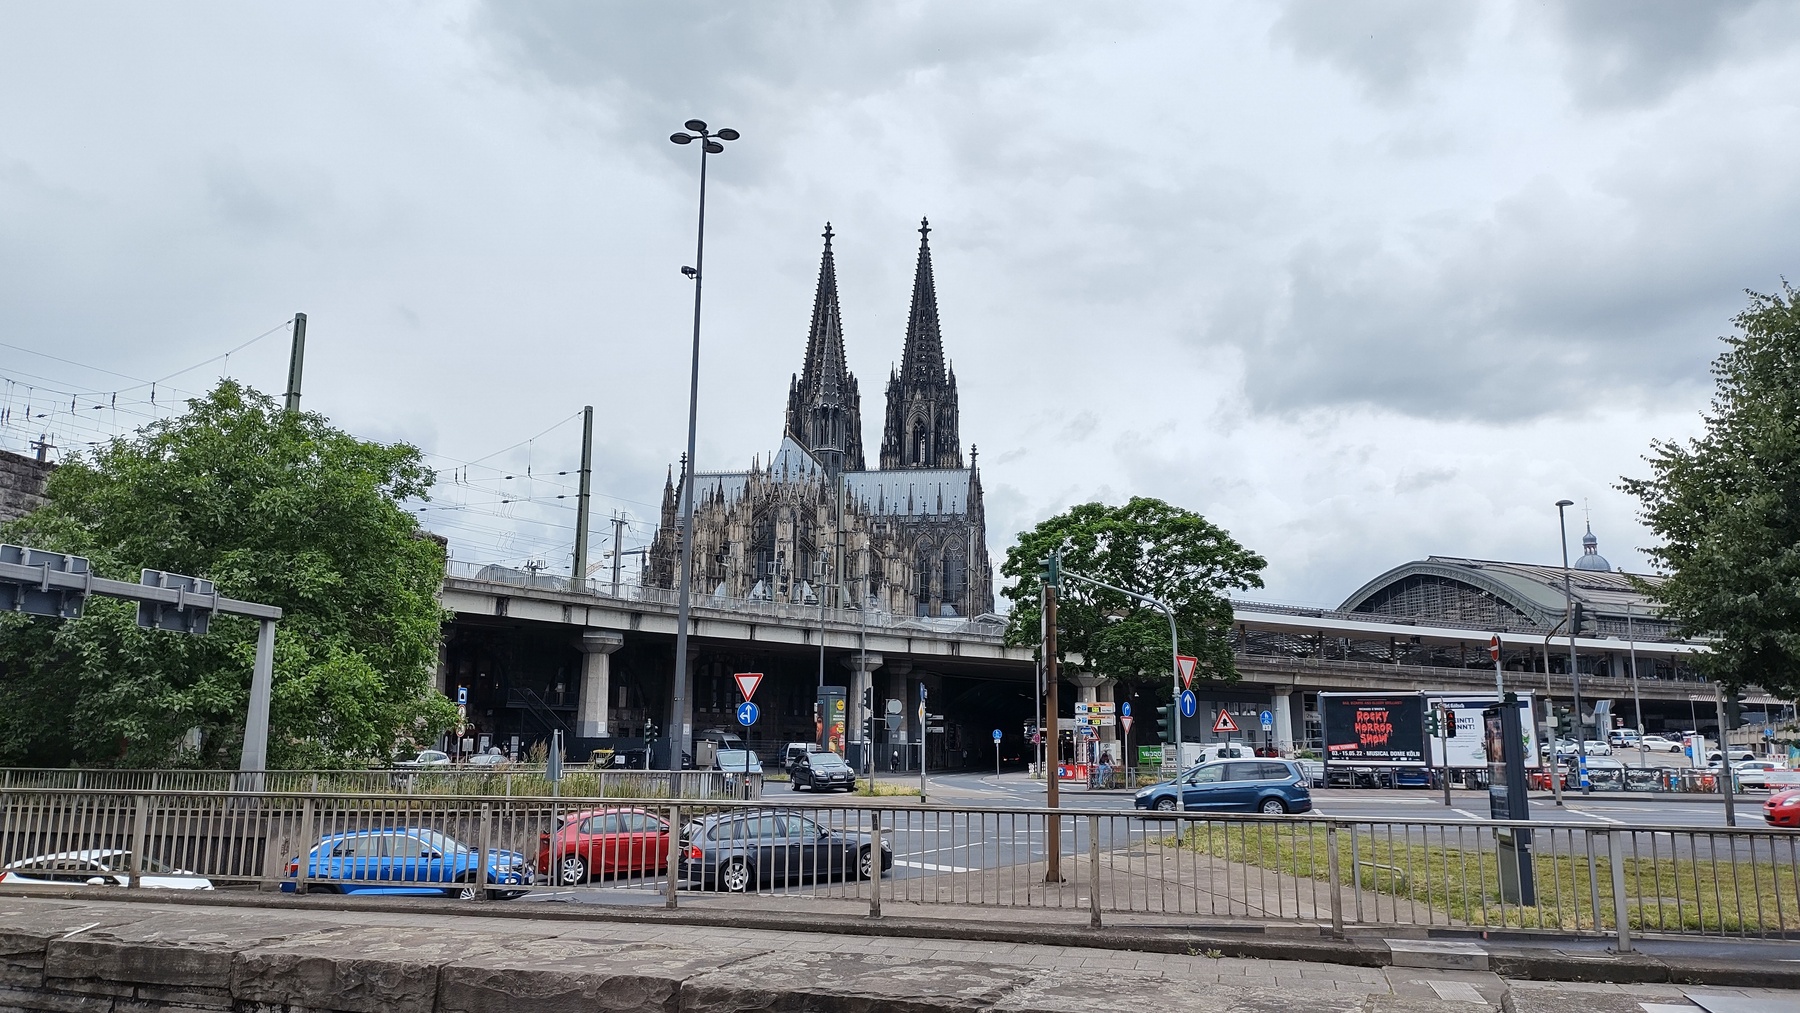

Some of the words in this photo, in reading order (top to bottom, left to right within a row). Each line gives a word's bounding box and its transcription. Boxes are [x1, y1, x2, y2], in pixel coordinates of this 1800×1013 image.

[1356, 711, 1389, 722] ROCKY
[1354, 722, 1393, 735] HORROR
[1360, 733, 1389, 746] SHOW
